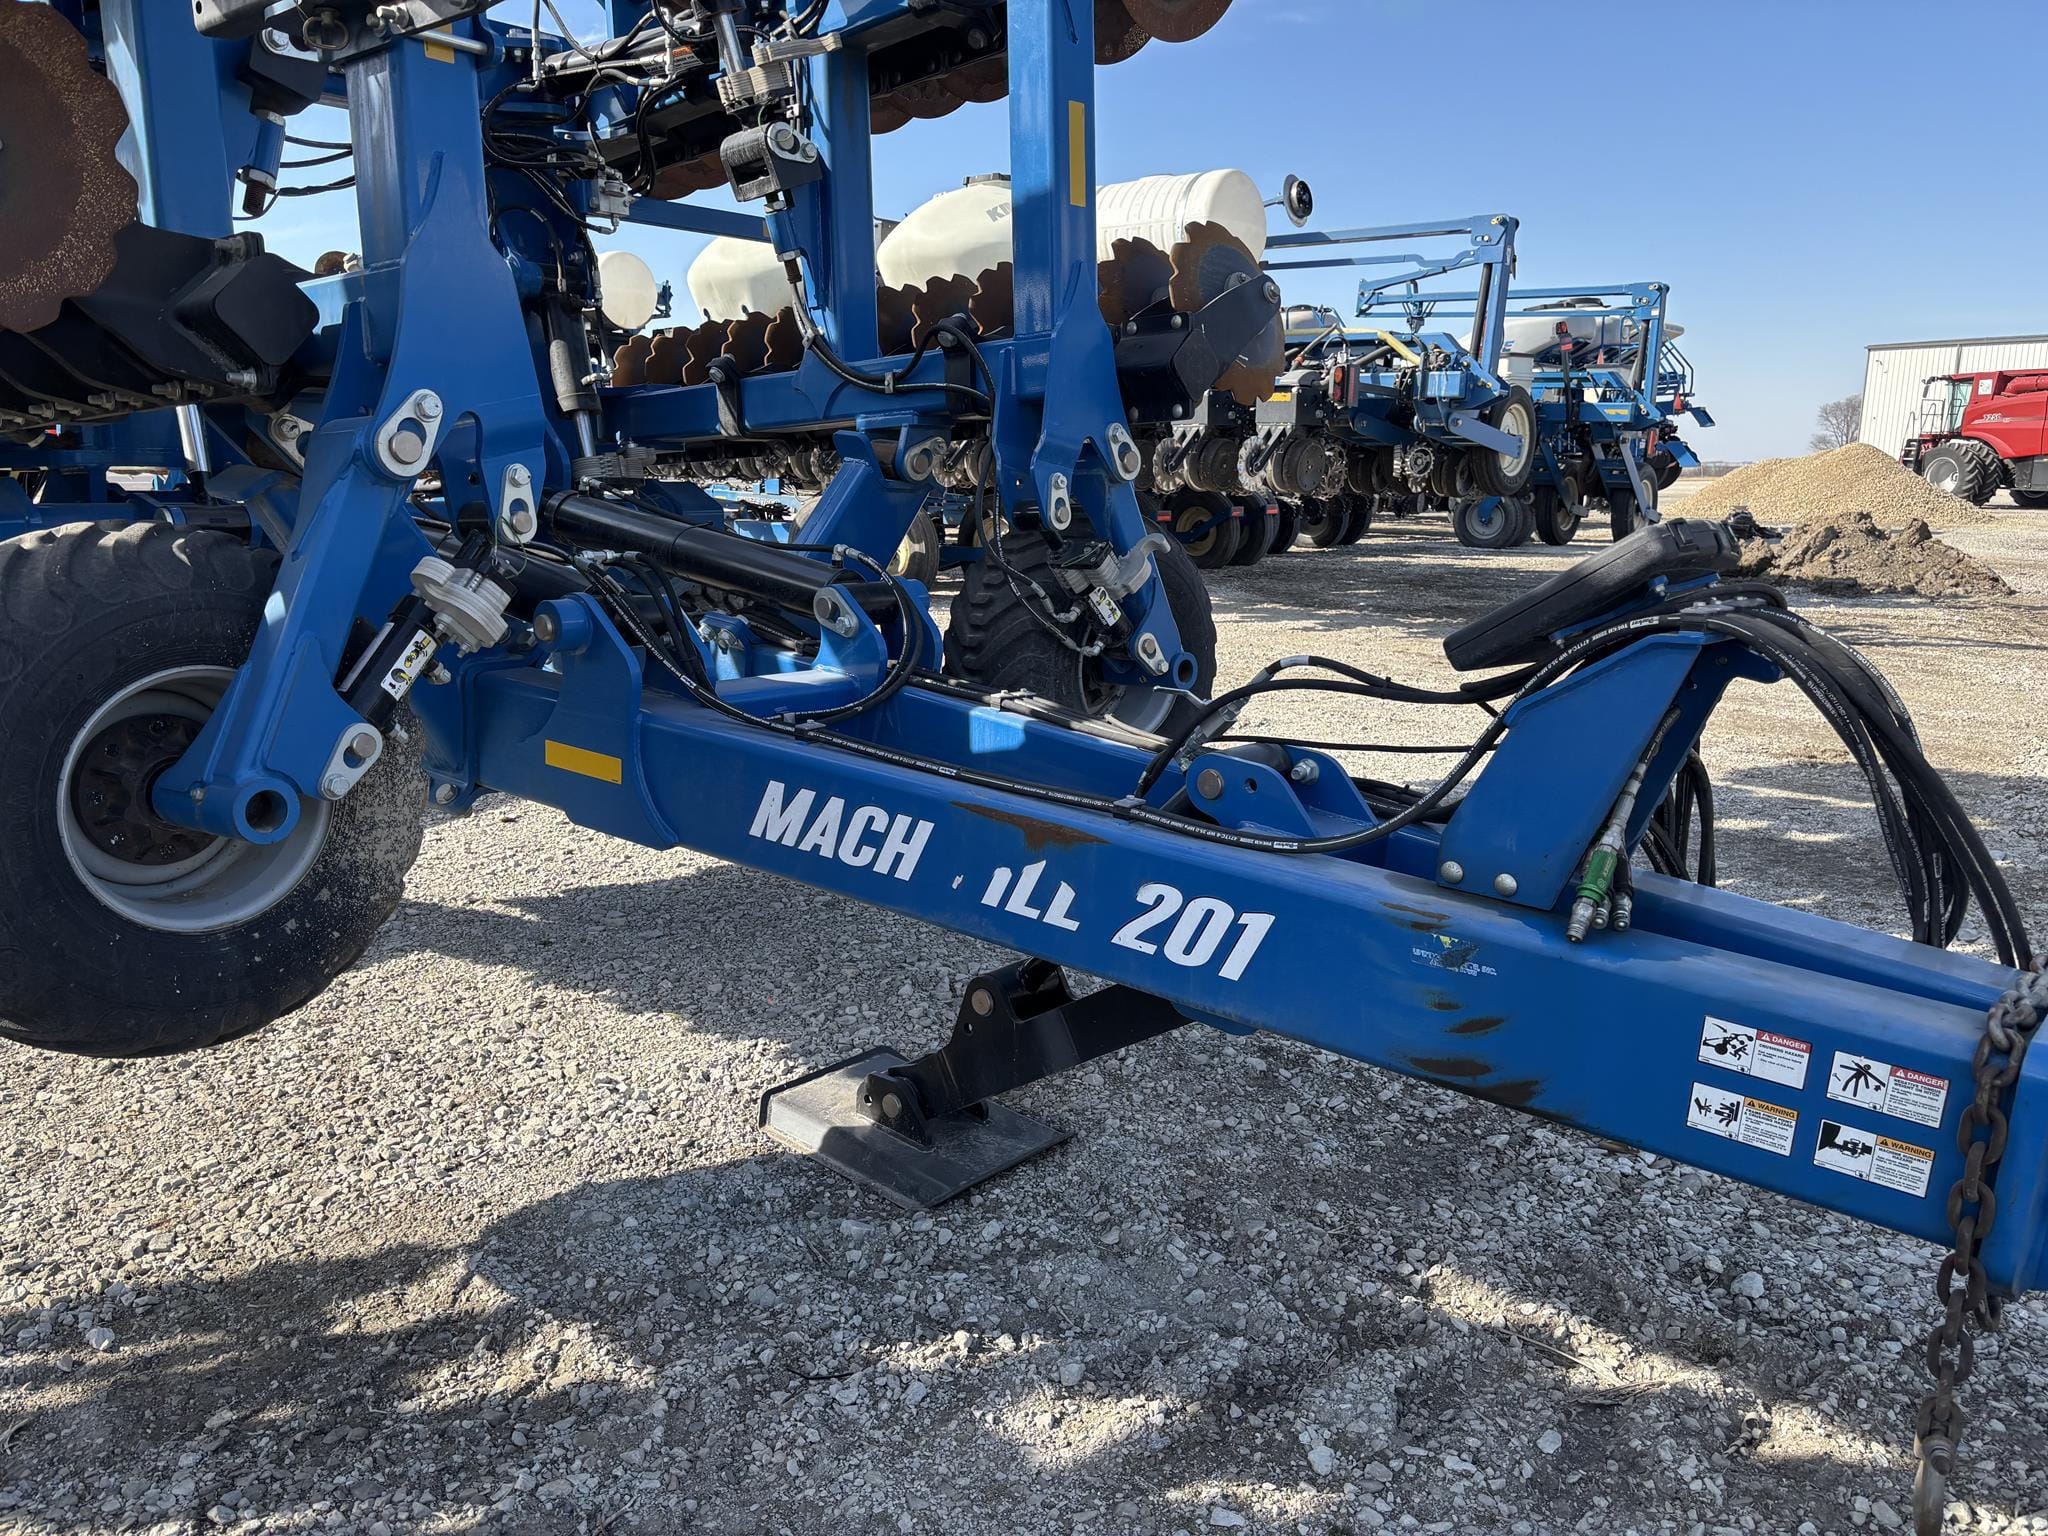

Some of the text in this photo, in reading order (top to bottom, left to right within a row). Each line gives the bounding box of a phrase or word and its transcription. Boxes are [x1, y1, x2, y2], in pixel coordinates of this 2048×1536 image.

[749, 780, 935, 881] MACH
[1111, 883, 1276, 981] 201
[1771, 1036, 1806, 1050] DANGER
[1906, 1072, 1943, 1086] DANGER
[1758, 1102, 1795, 1118] WARNING
[1890, 1141, 1931, 1157] WARNING
